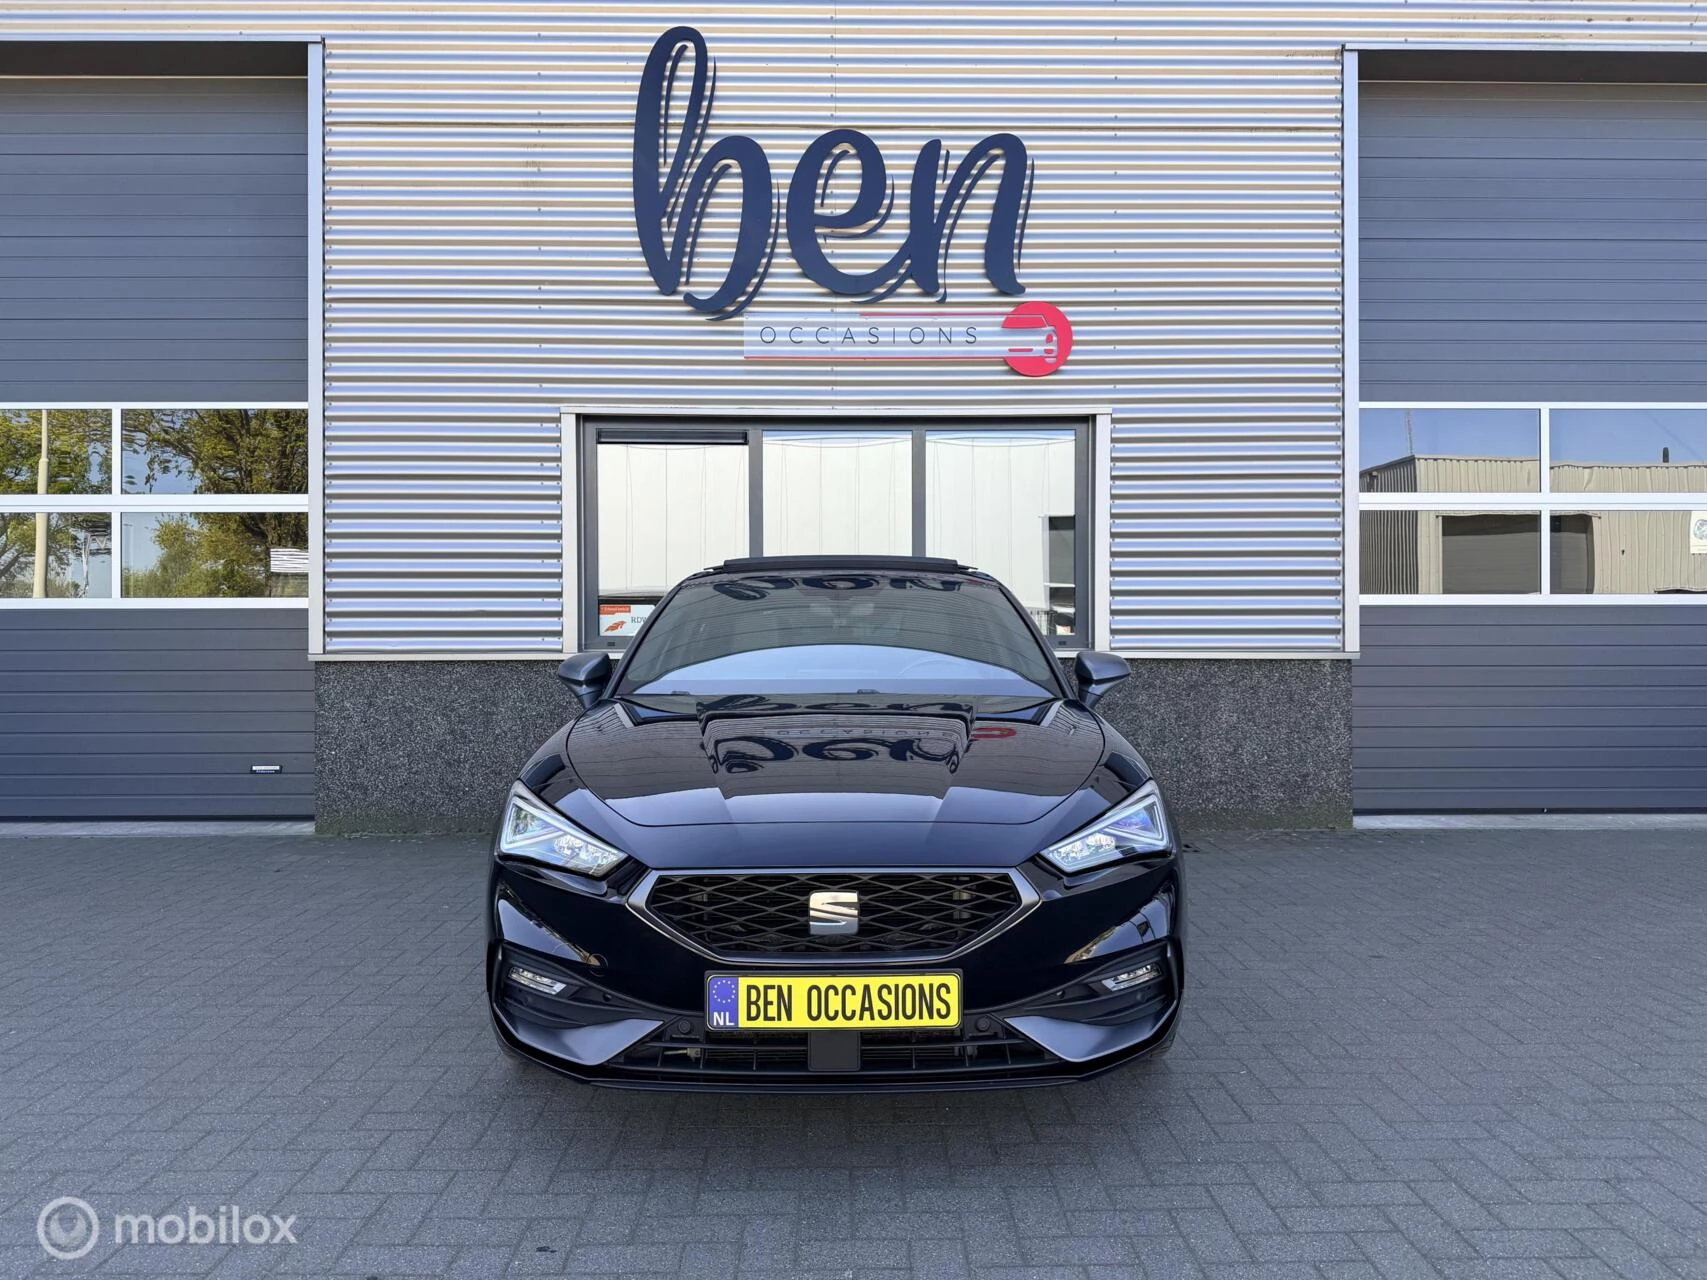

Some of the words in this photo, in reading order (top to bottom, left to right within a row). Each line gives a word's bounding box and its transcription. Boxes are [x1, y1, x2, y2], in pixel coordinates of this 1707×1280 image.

[633, 26, 1034, 320] ben
[759, 326, 979, 345] OCCASIONS
[746, 984, 793, 1022] BEN
[807, 982, 951, 1022] OCCASIONS
[713, 1011, 734, 1026] NL
